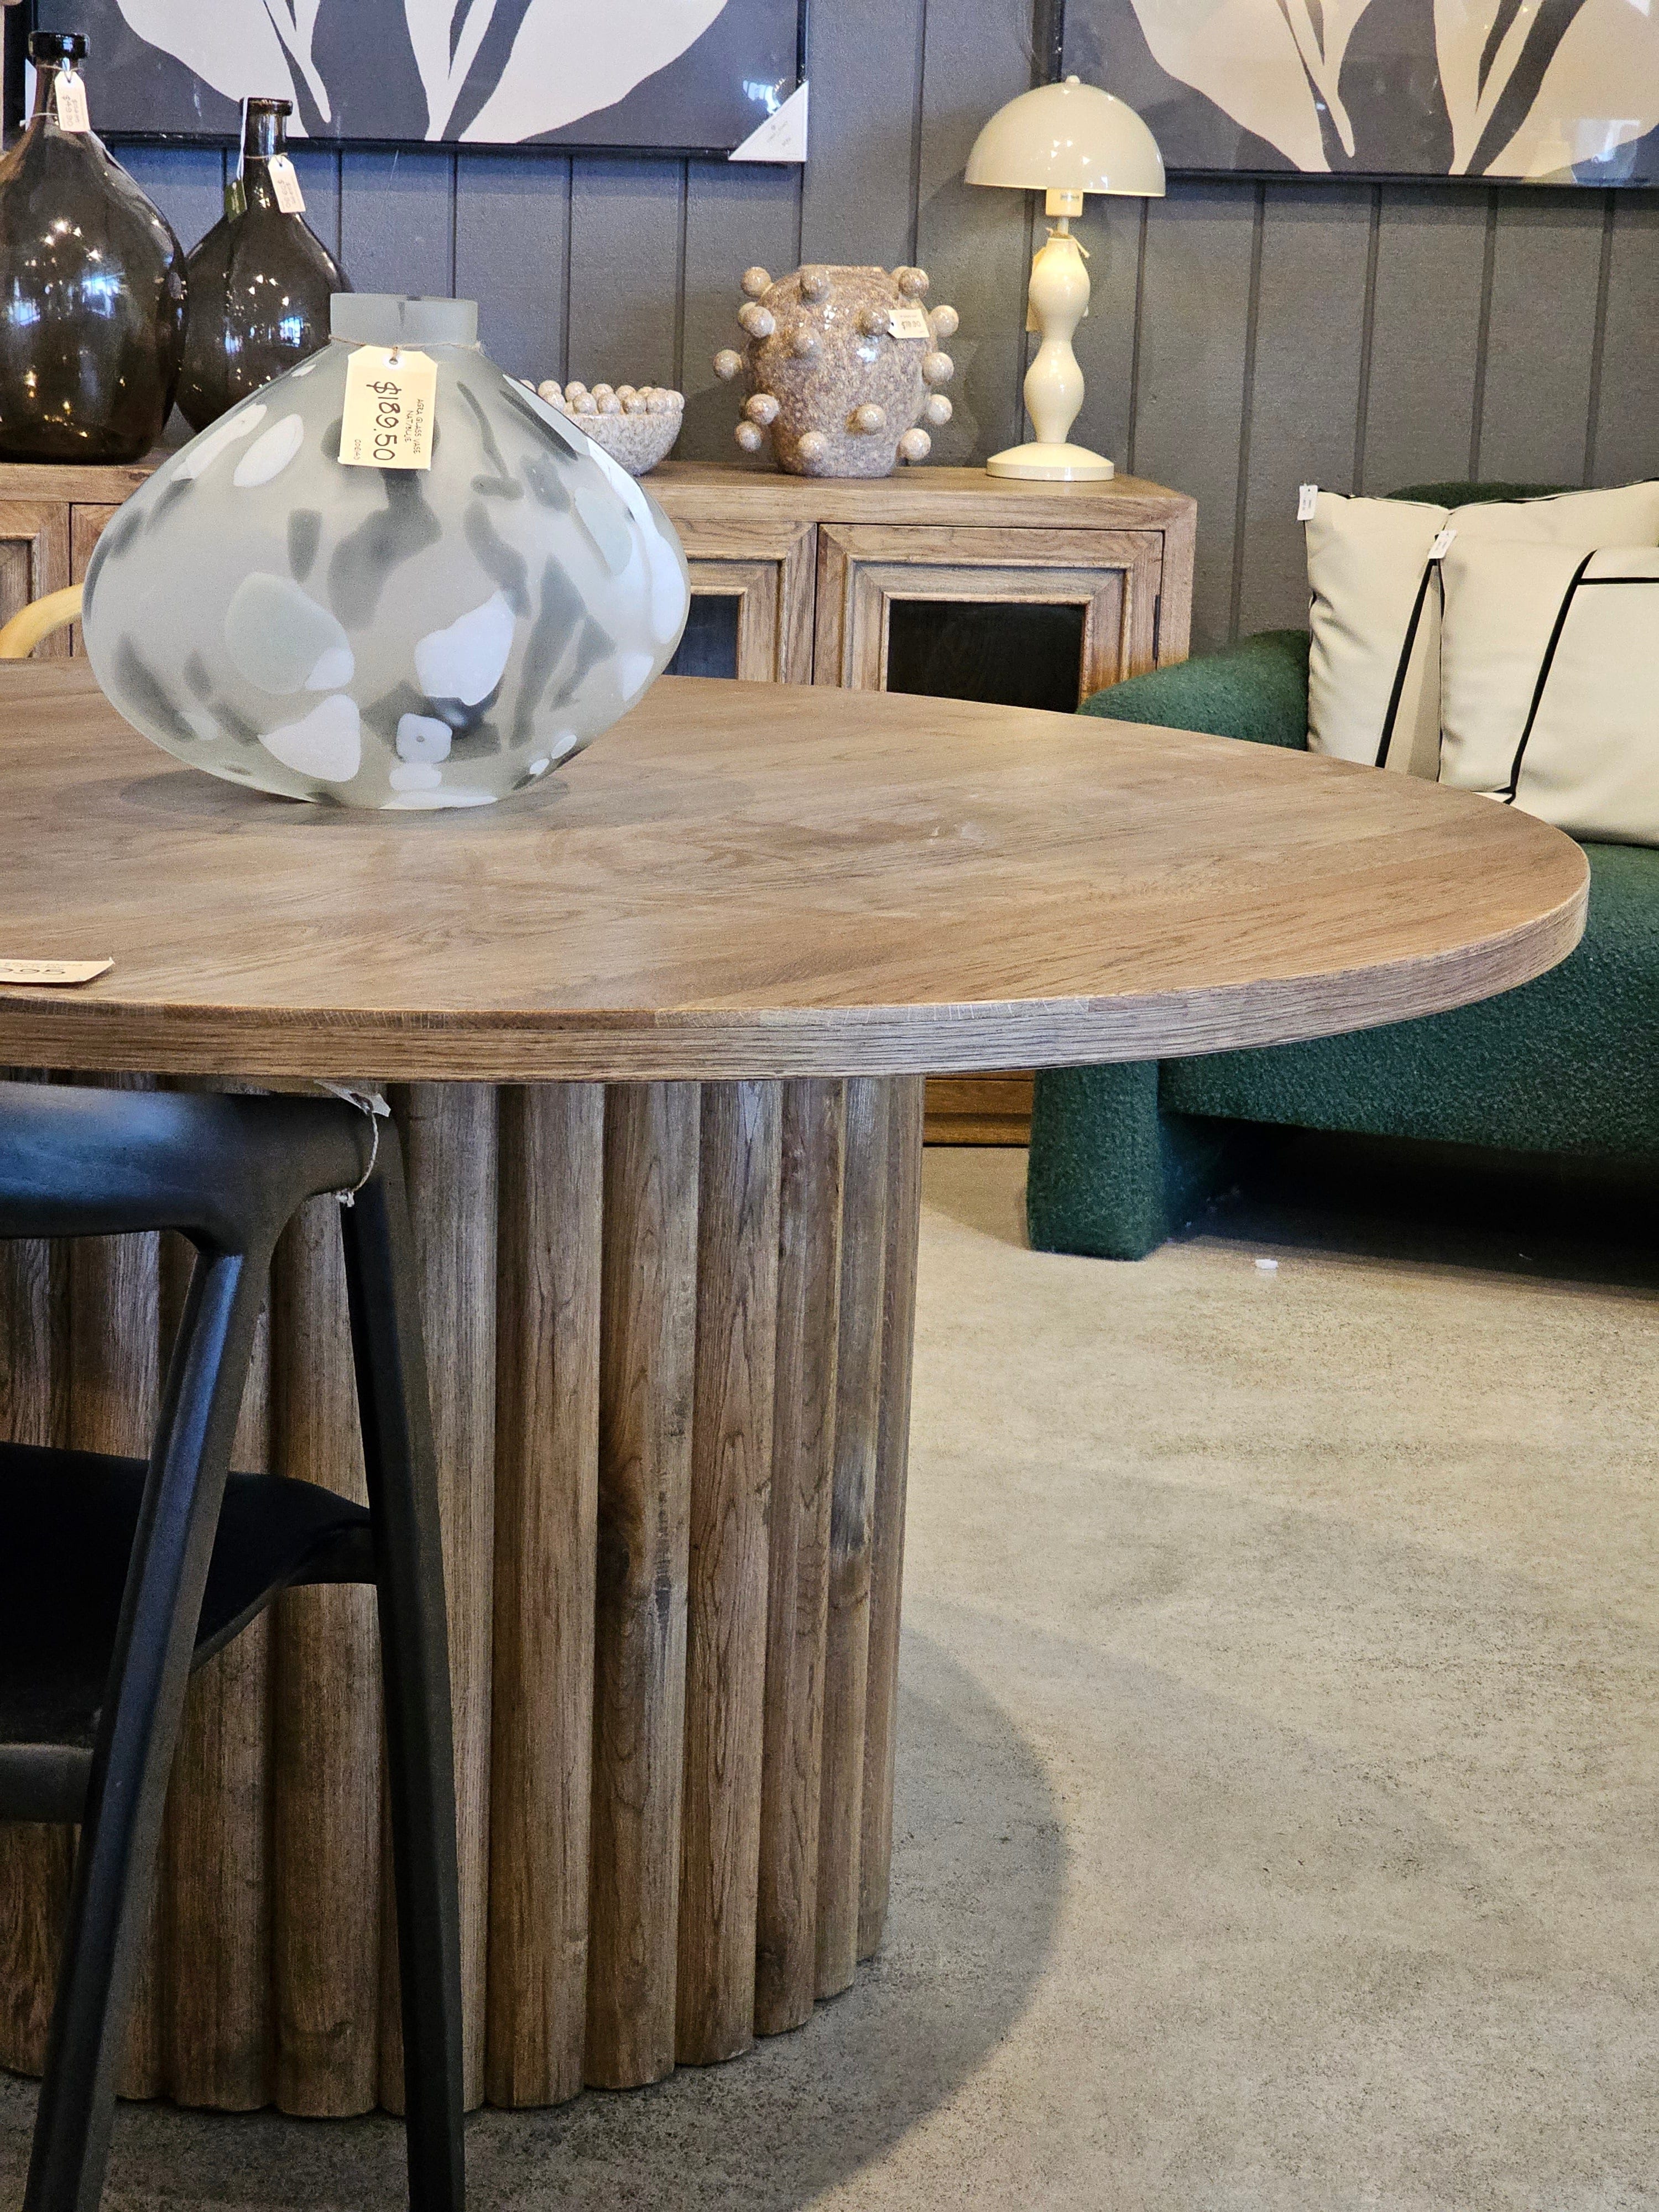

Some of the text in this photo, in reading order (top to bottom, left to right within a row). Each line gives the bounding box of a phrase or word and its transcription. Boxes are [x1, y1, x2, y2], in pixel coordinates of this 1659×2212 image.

[416, 399, 424, 415] AGRA
[366, 381, 402, 461] $189.50
[404, 410, 414, 442] NAT/BLUE
[414, 418, 423, 437] GLASS
